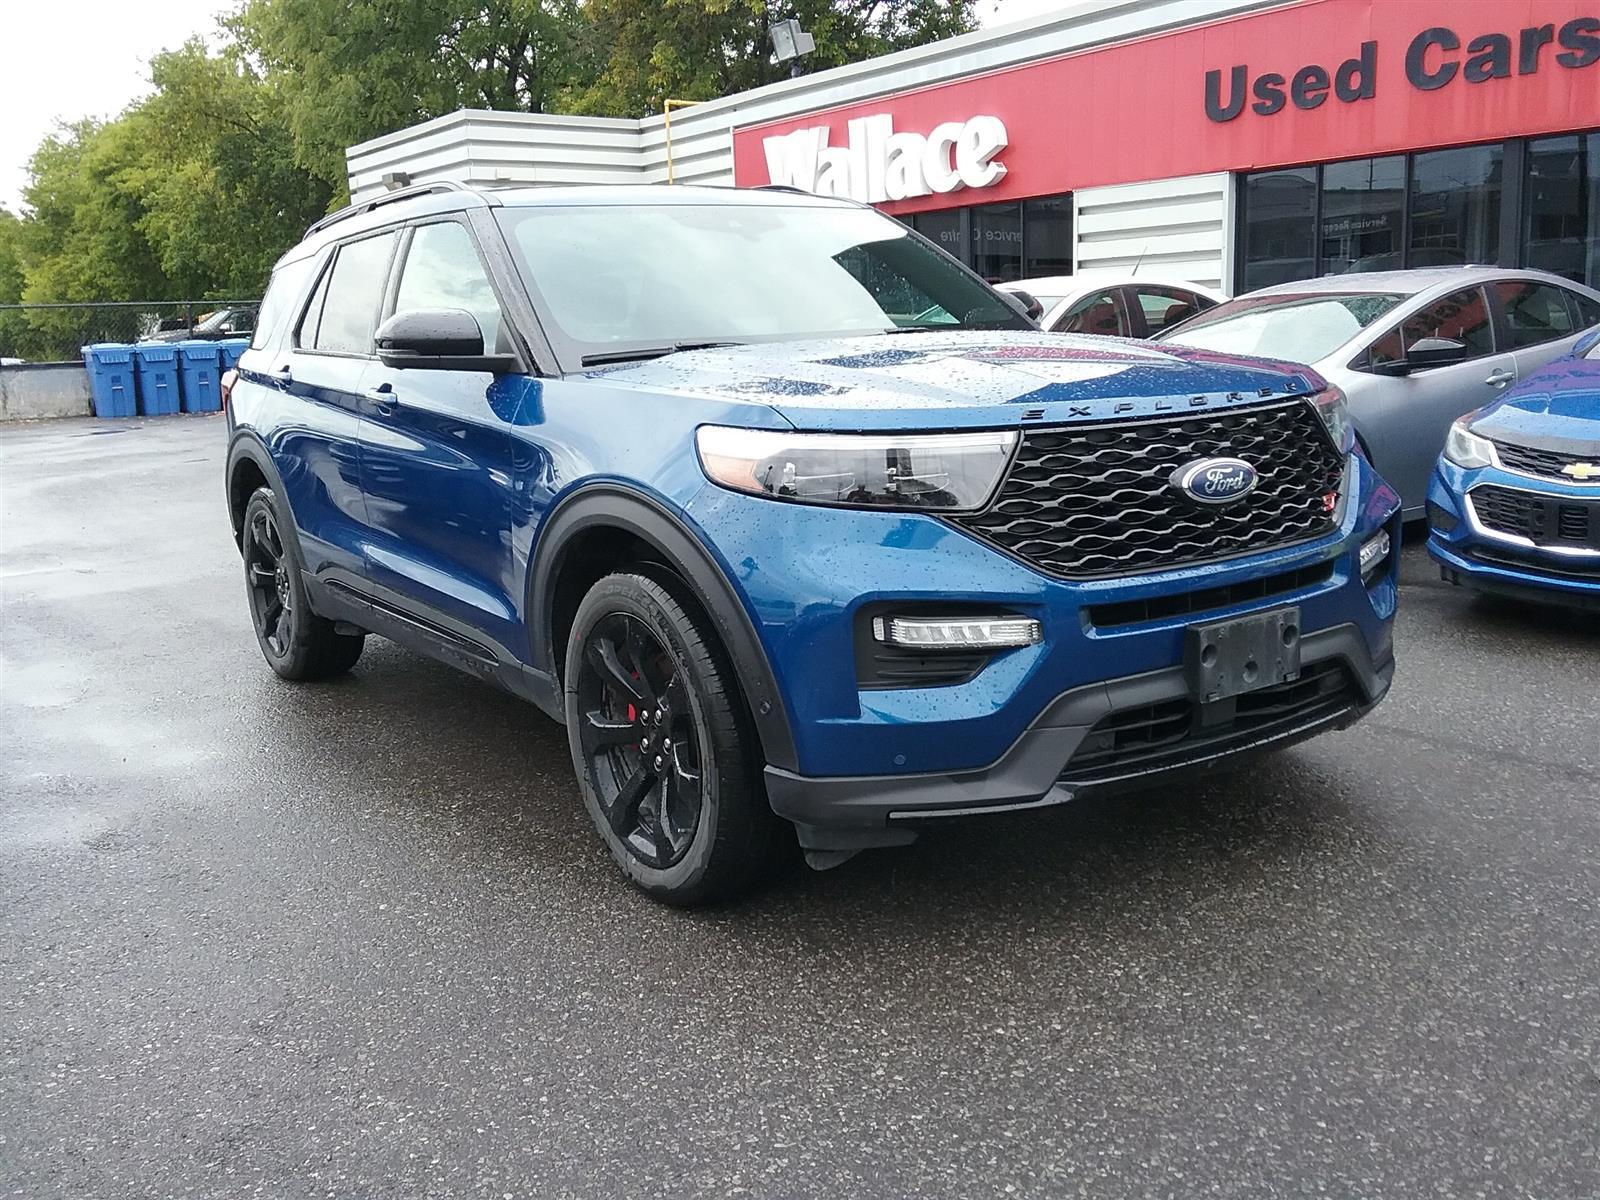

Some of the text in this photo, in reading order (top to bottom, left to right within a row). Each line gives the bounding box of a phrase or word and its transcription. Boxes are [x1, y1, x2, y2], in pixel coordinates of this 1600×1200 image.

[1204, 16, 1600, 123] Used Cars
[762, 113, 1008, 204] Wallace
[1020, 382, 1298, 421] EXPLORER
[1205, 467, 1246, 494] Ford
